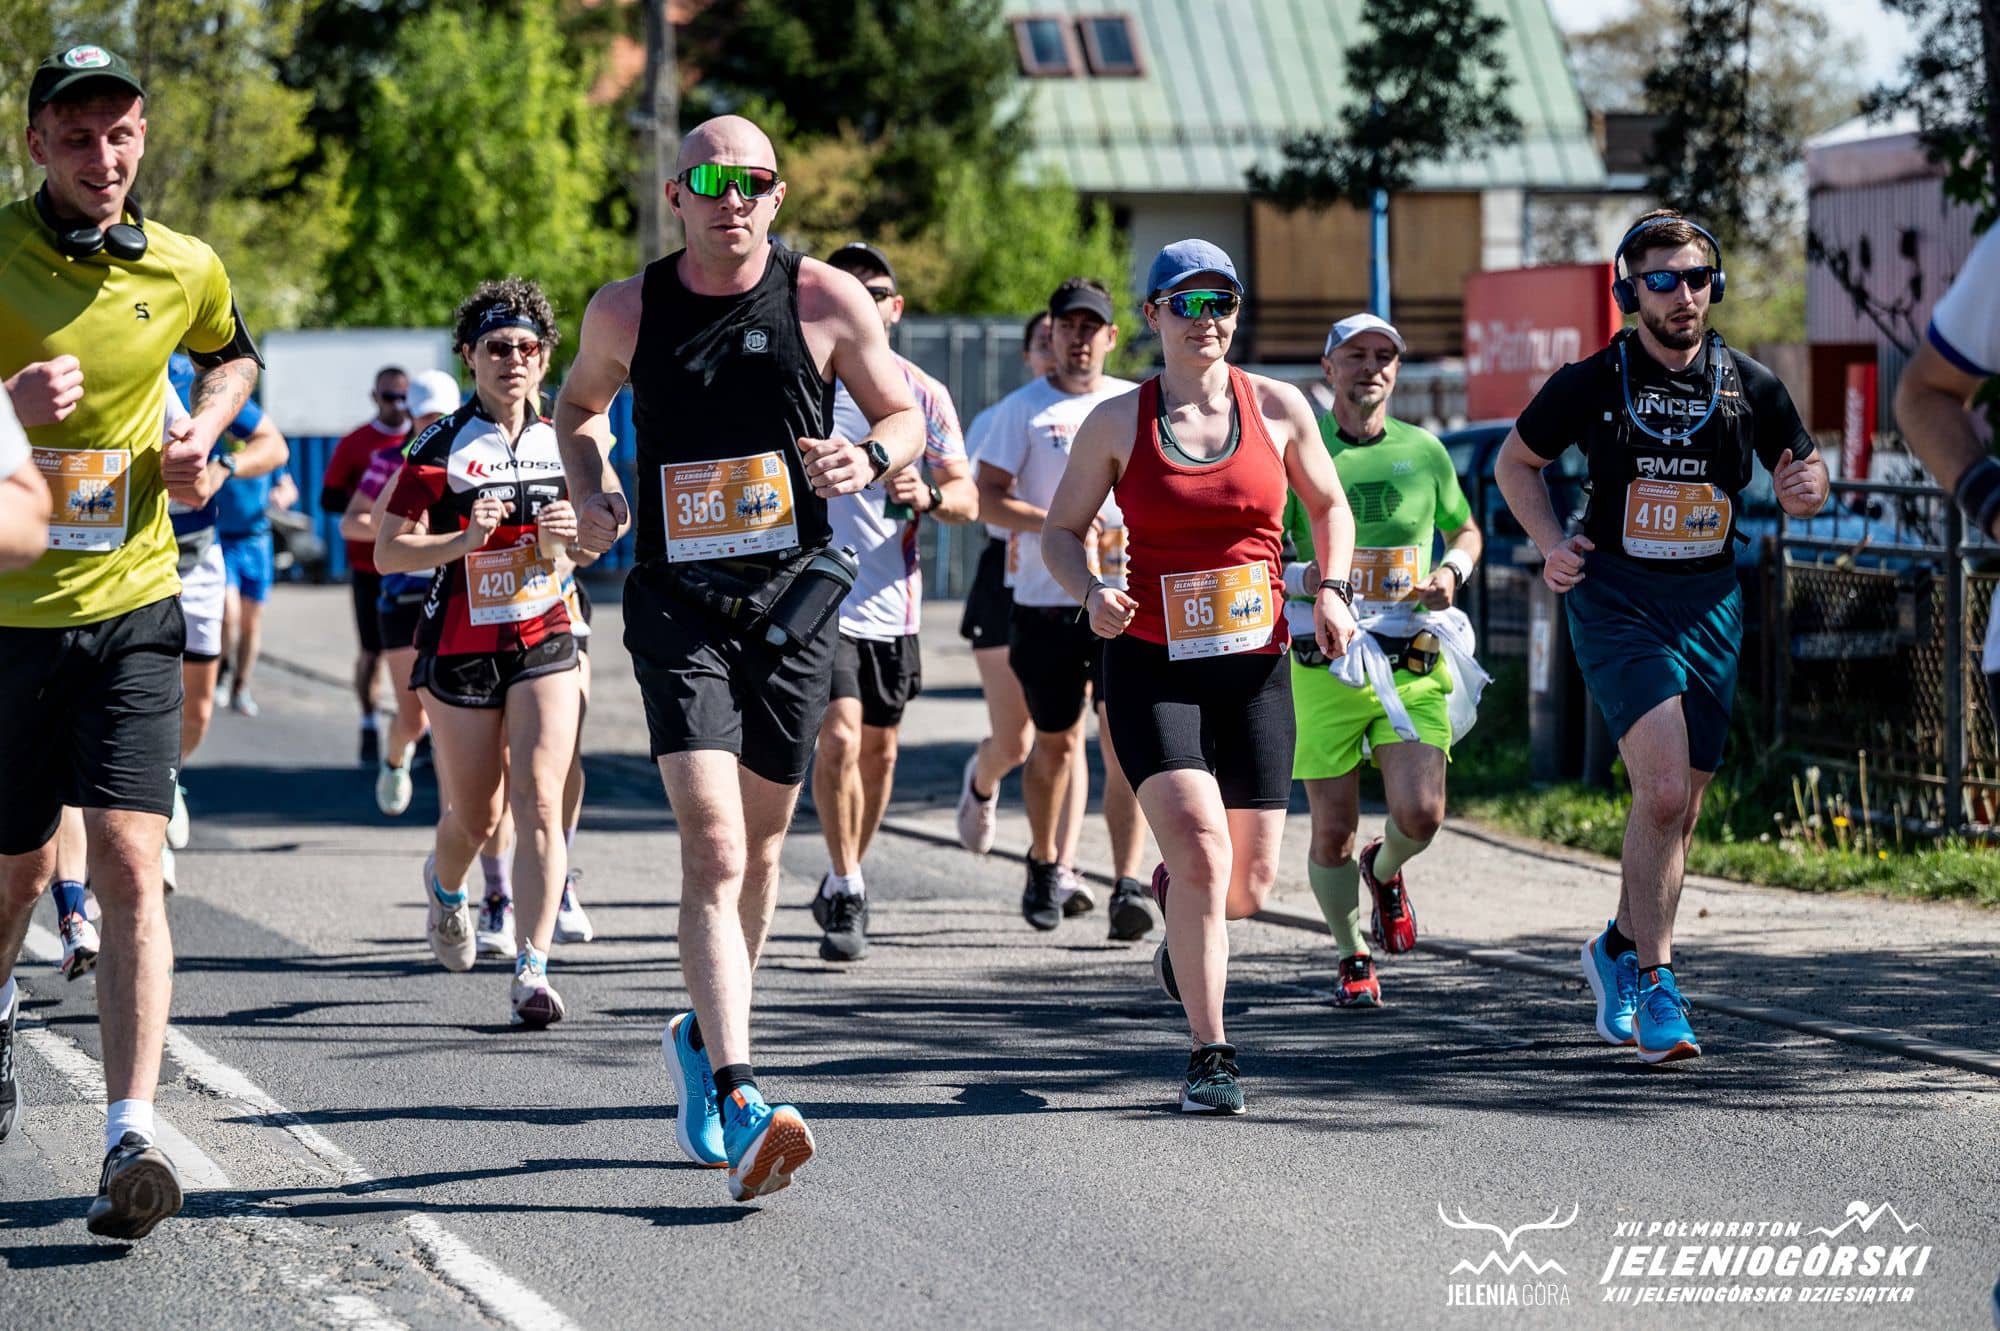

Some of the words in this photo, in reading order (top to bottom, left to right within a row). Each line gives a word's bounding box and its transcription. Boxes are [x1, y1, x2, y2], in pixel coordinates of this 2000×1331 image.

[676, 490, 726, 525] 356
[1635, 502, 1677, 531] 419
[478, 571, 516, 597] 420
[1184, 597, 1214, 627] 85
